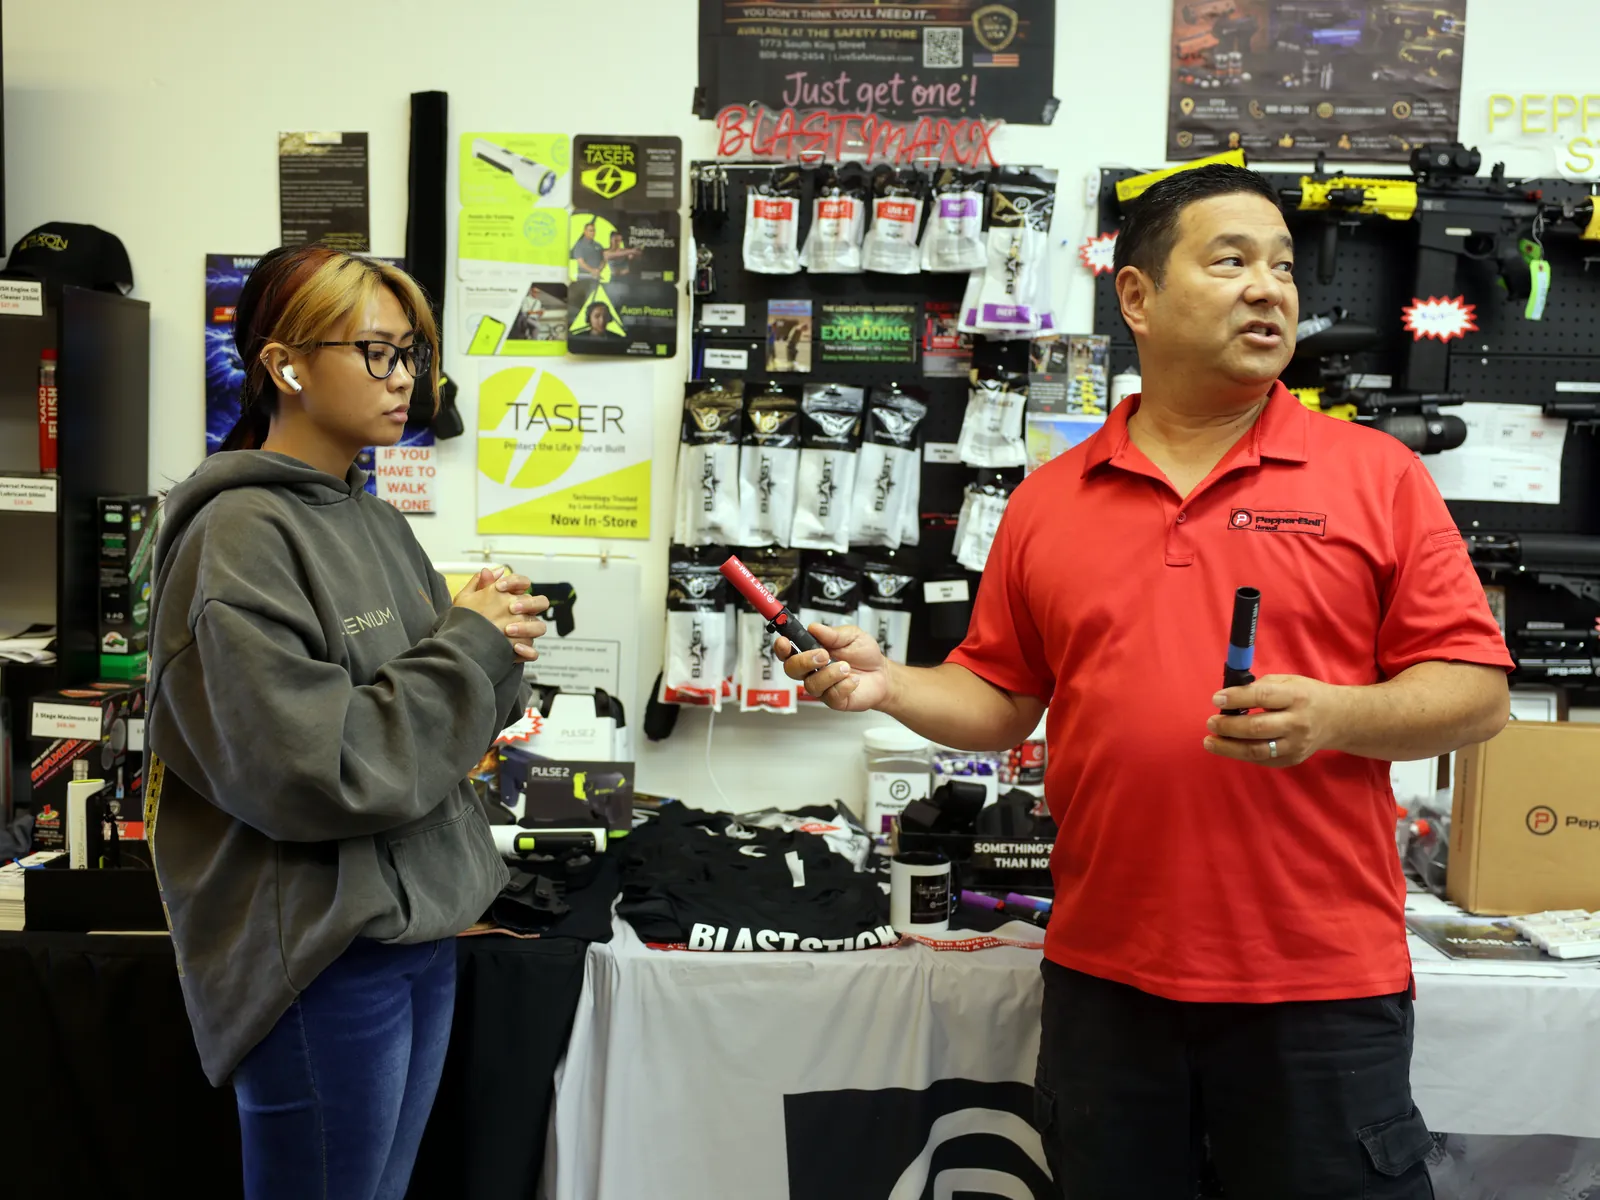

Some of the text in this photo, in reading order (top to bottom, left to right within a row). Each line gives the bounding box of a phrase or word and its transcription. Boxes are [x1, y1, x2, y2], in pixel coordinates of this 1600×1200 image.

[743, 8, 765, 18] YOU
[767, 8, 799, 18] DON'T
[801, 9, 832, 18] THINK
[835, 9, 873, 18] YOU'LL
[876, 9, 912, 19] NEED
[737, 26, 917, 39] AVAILABLE AT THE SAFETY STORE
[760, 39, 866, 51] 1773 South King Street
[783, 73, 978, 115] Just get one!
[584, 150, 635, 166] TASER
[629, 225, 665, 240] Training
[629, 236, 676, 248] Resources
[620, 305, 673, 318] Axon Protect
[820, 325, 911, 341] EXPLODING
[506, 402, 625, 434] TASER
[504, 440, 626, 454] Protect the Life You've Built
[384, 448, 431, 461] IF YOU
[377, 465, 437, 478] HAVE TO
[387, 482, 427, 494] WALK
[703, 453, 718, 512] BLAST
[759, 454, 774, 514] BLAST
[817, 458, 835, 517] BLAST
[874, 453, 894, 512] BLAST
[550, 514, 638, 528] Now In-Store
[1255, 516, 1320, 528] PepperBall
[738, 565, 752, 578] AIM
[755, 582, 769, 597] LIVE
[341, 606, 396, 636] ENIUM
[690, 619, 705, 679] BLAST
[40, 712, 56, 720] Stage
[560, 729, 596, 738] PULSE 2
[531, 766, 570, 778] PULSE 2
[1565, 816, 1600, 831] Pep
[974, 842, 1054, 855] SOMETHING'S
[994, 857, 1028, 869] THAN
[956, 936, 993, 947] Market
